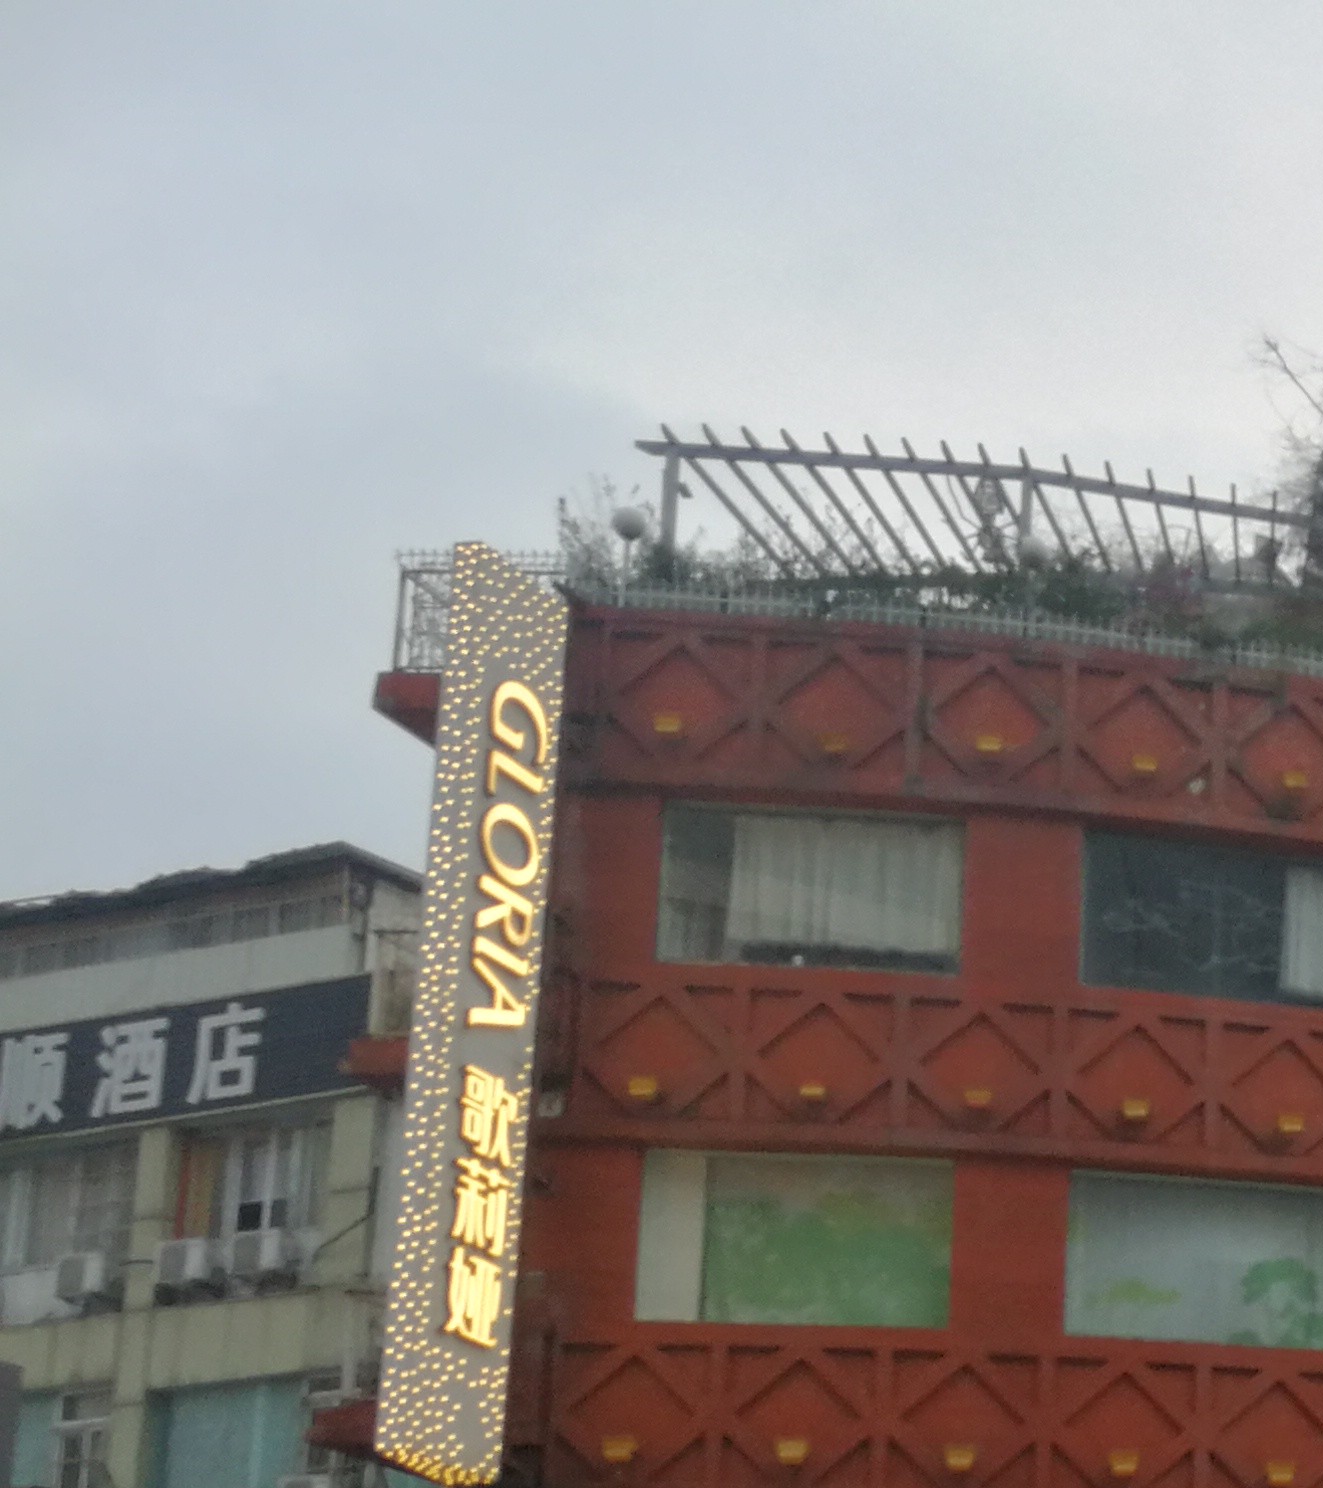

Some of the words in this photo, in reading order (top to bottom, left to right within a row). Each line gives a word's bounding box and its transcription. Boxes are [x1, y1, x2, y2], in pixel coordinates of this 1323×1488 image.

[466, 679, 548, 1031] GLORIA
[443, 1063, 520, 1350] 歌莉娅
